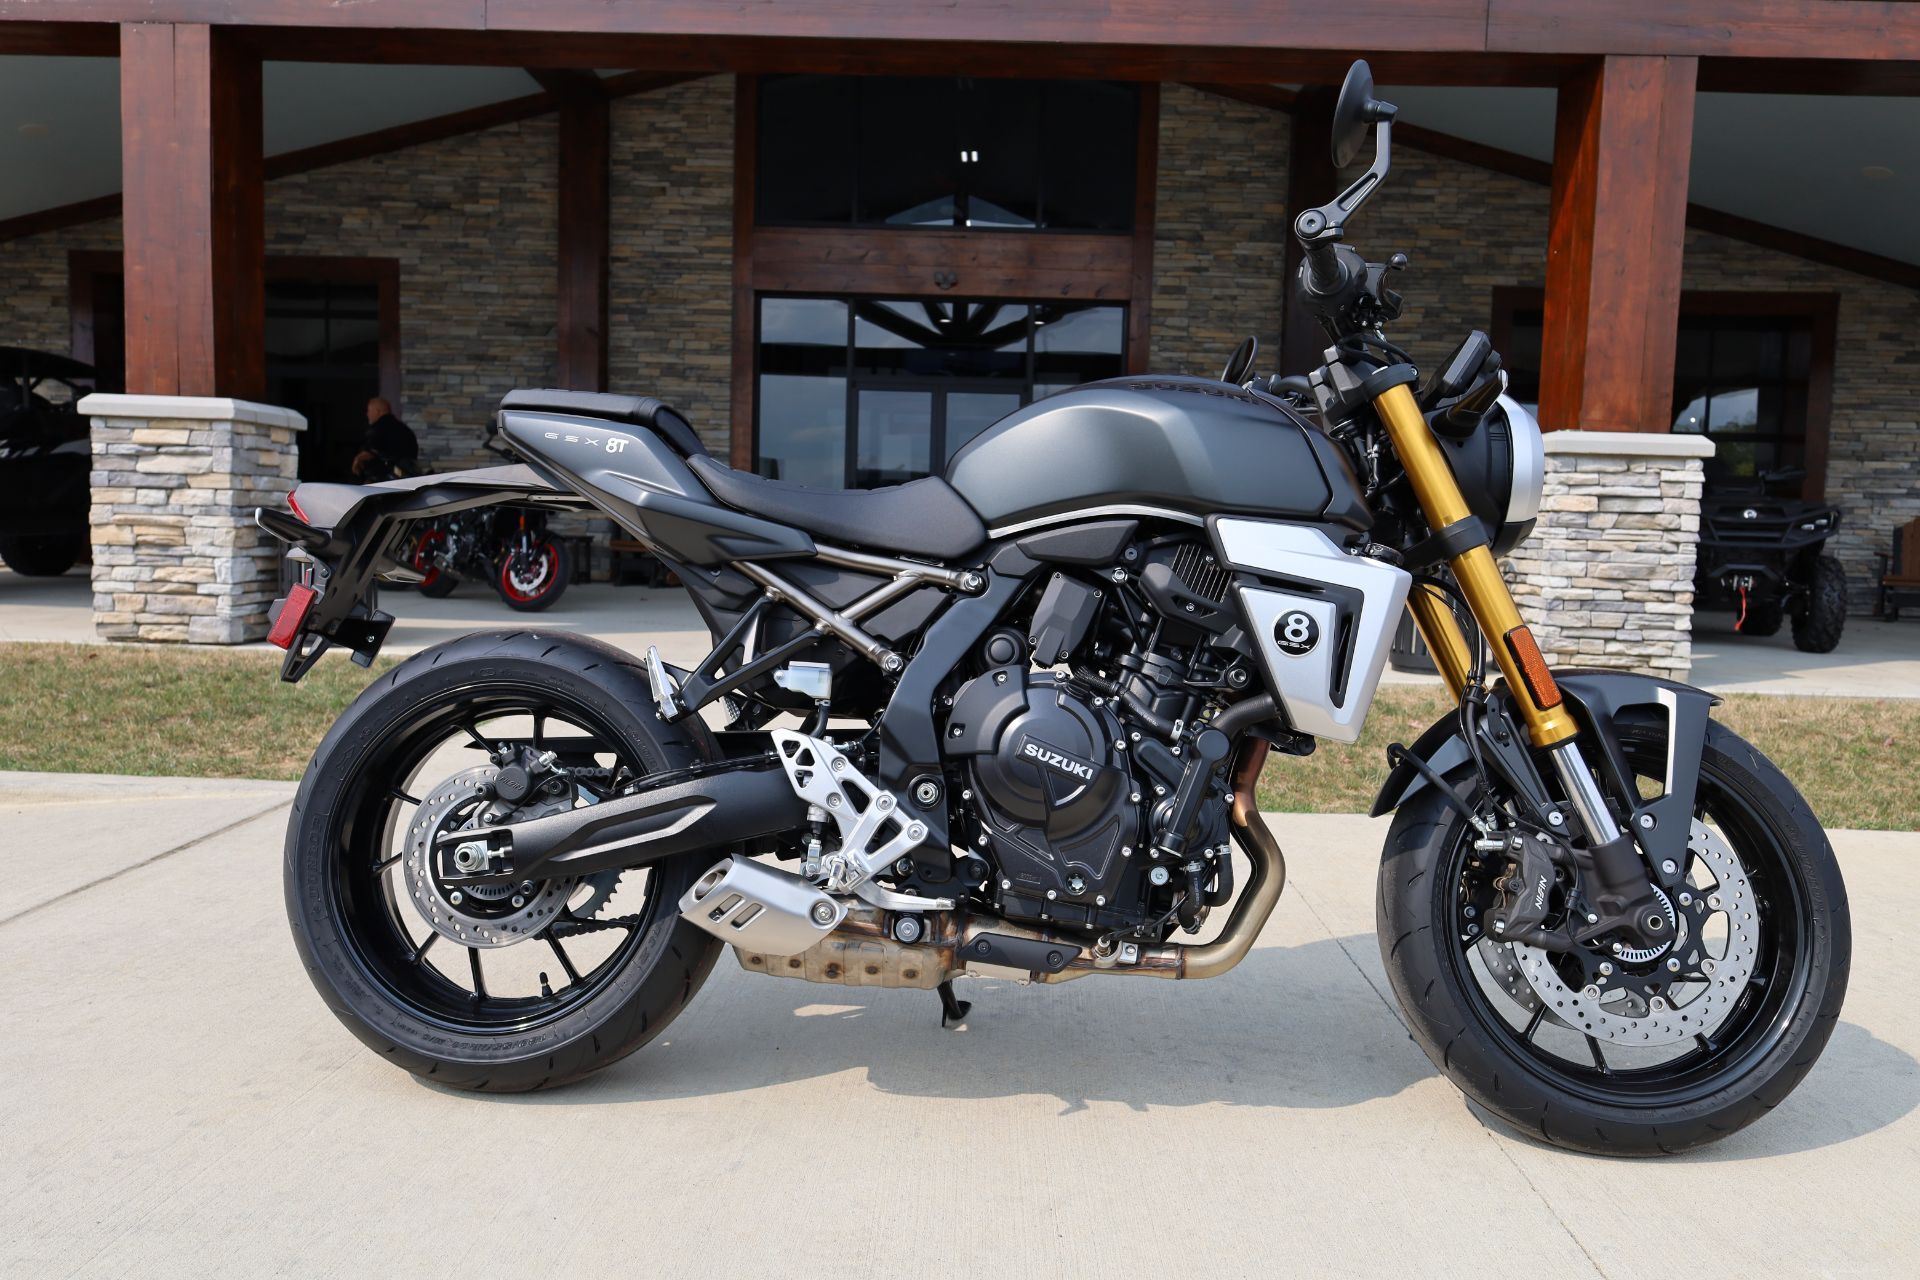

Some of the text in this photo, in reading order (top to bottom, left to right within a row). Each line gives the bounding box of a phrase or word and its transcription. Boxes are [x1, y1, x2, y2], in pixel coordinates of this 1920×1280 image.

[605, 437, 629, 453] 8T
[1284, 613, 1310, 642] 8
[1277, 640, 1311, 650] GSX
[1024, 743, 1093, 780] SUZUKI
